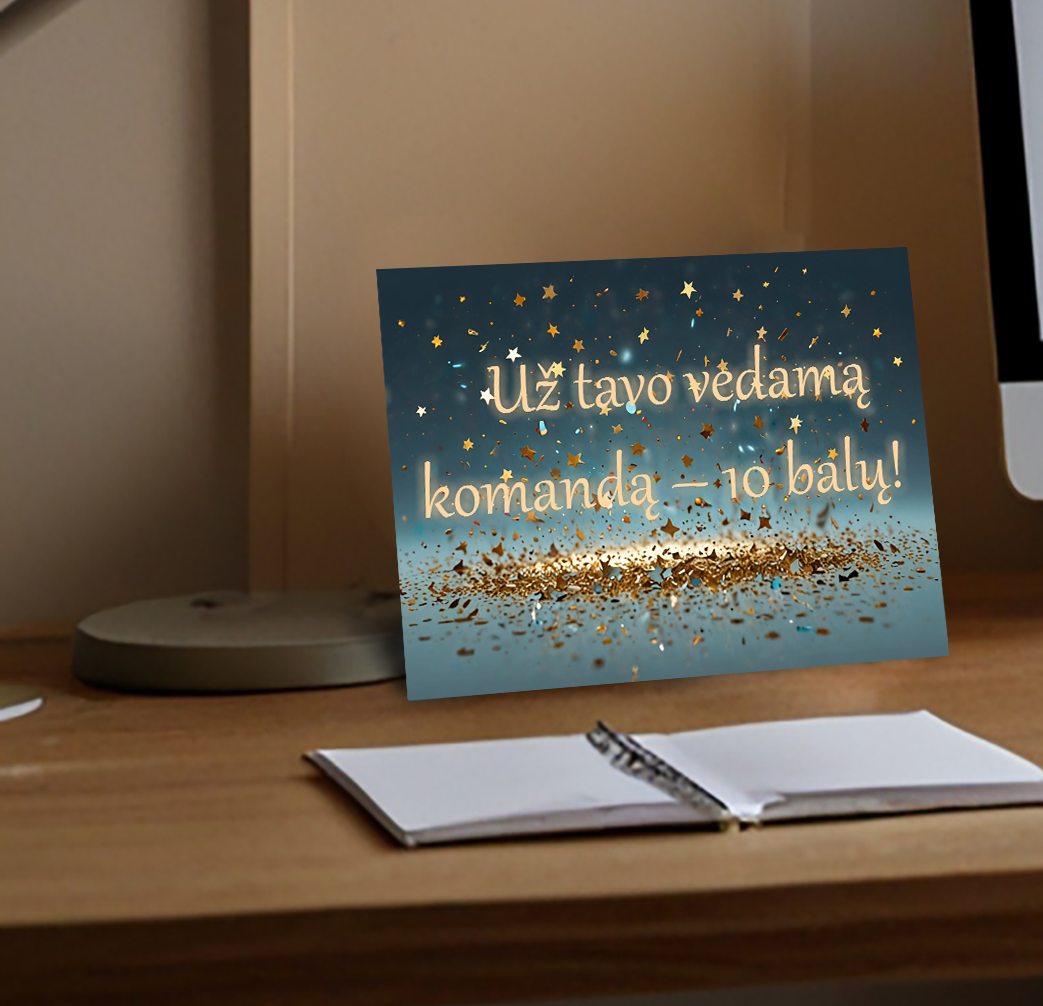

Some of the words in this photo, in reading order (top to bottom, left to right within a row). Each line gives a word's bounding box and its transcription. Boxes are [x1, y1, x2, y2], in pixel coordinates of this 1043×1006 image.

[486, 362, 560, 414] Už
[572, 363, 673, 410] tavo
[682, 344, 872, 410] vedamą
[424, 449, 660, 521] komandą
[721, 465, 770, 499] 10
[786, 435, 902, 505] balų!
